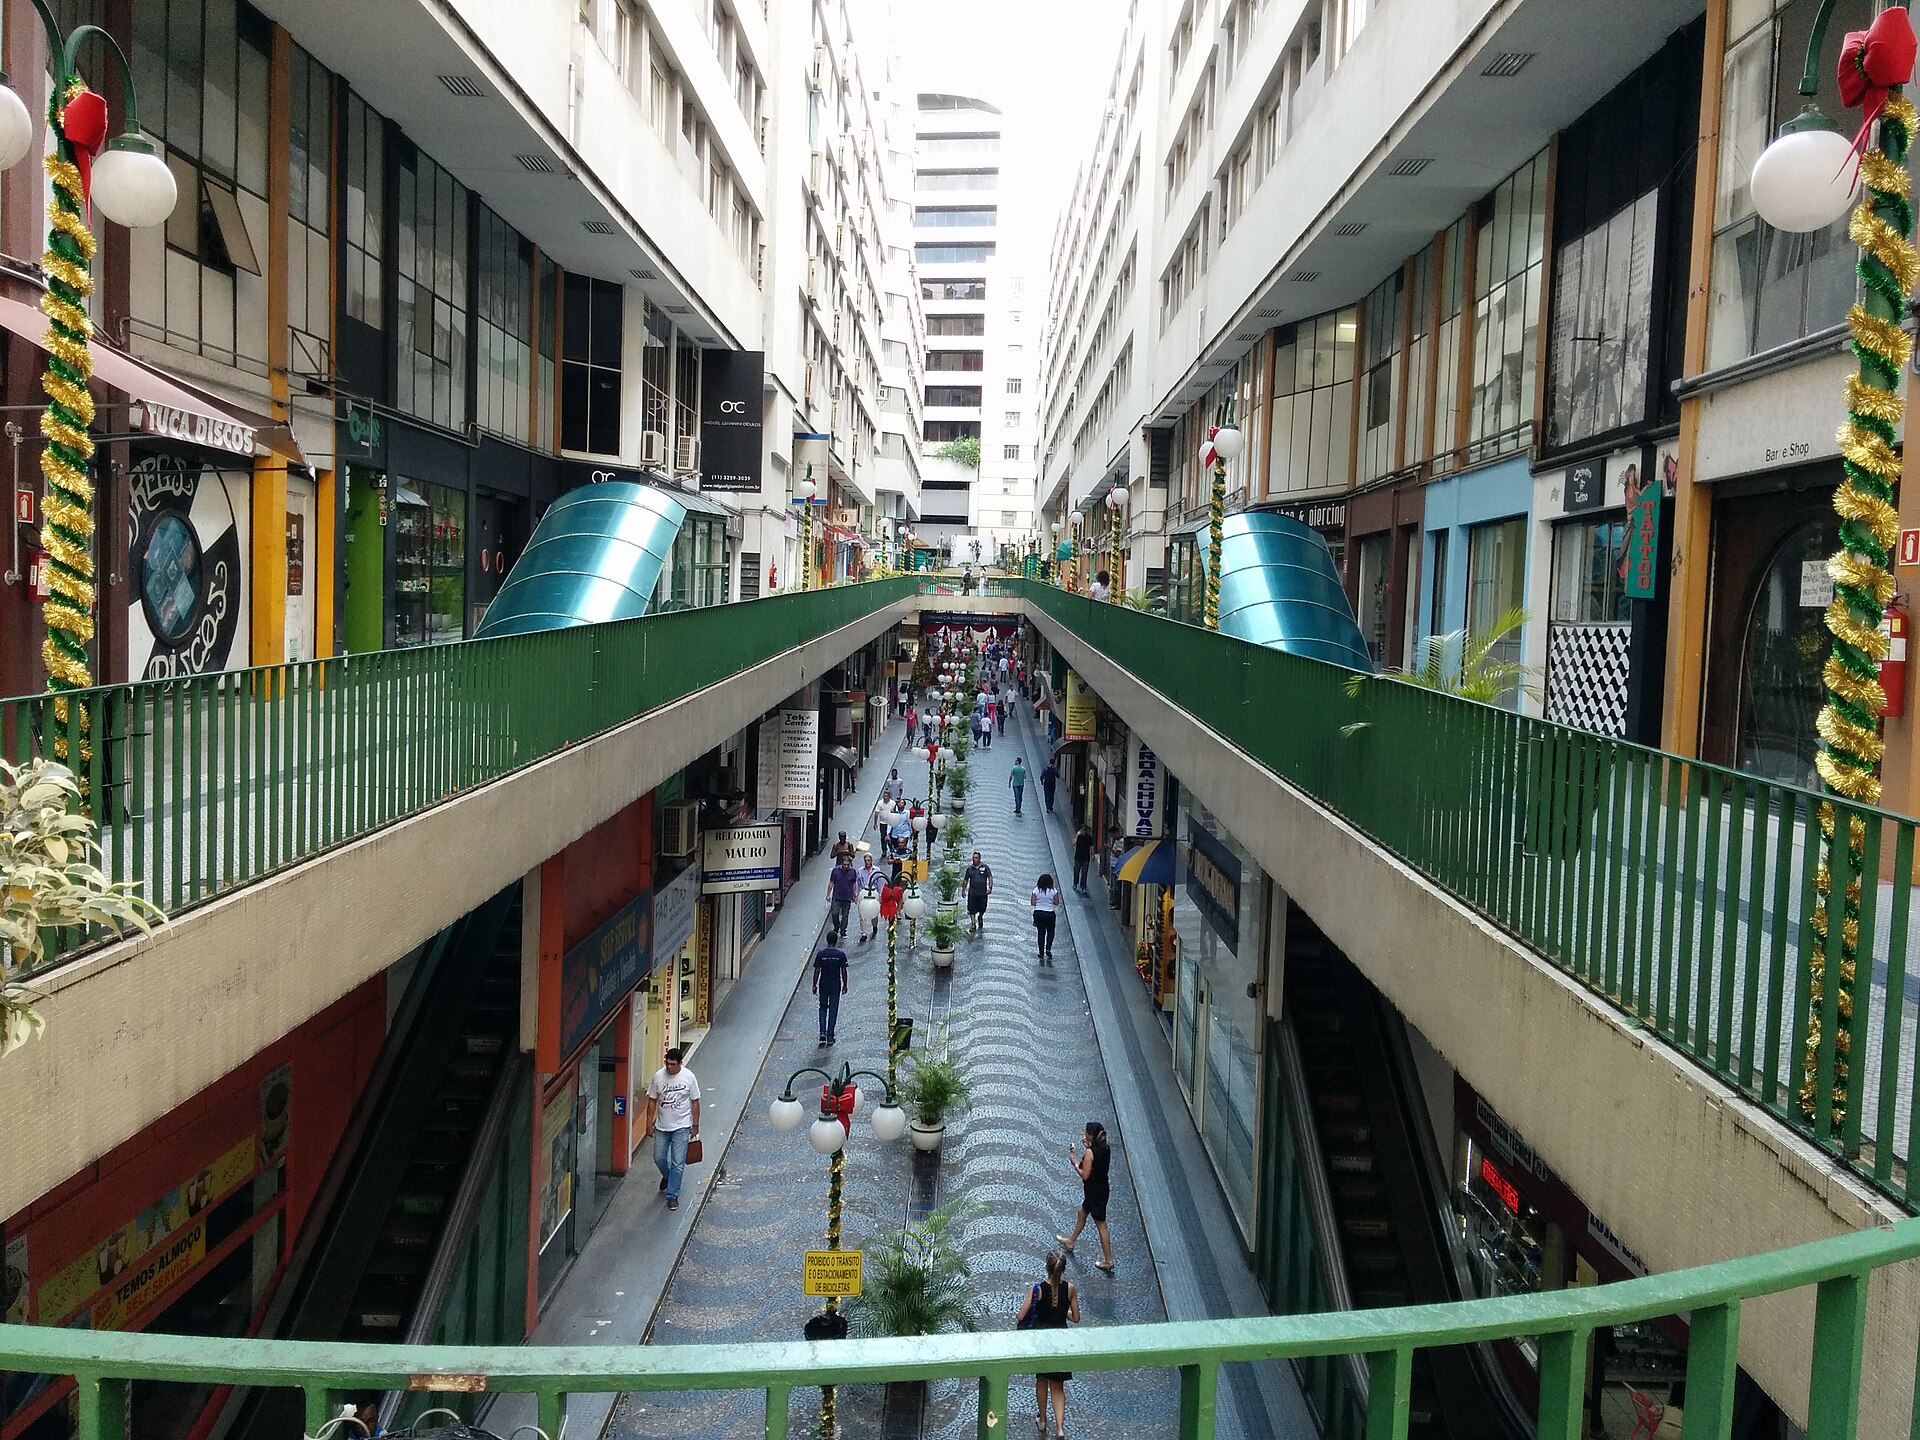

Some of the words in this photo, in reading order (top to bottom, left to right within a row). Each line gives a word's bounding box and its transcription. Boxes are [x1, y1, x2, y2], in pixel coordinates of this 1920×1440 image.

[146, 402, 191, 439] TUCA
[195, 415, 254, 454] DISCOS
[1765, 448, 1778, 462] Bar
[1782, 447, 1788, 459] e
[1789, 442, 1810, 457] Shop
[1637, 501, 1656, 590] TATTOO
[785, 713, 805, 721] Tek
[715, 829, 771, 842] RELOJOARIA
[724, 846, 767, 860] MAURO
[665, 965, 673, 1013] CONSERTO
[665, 1018, 671, 1030] DE
[116, 1263, 155, 1304] TEMOS
[158, 1226, 201, 1274] ALMOÇO
[807, 1256, 830, 1267] PROIBIDO
[830, 1256, 836, 1267] O
[836, 1254, 860, 1267] TRÂNSITO
[808, 1269, 812, 1280] E
[812, 1269, 817, 1280] O
[817, 1268, 858, 1280] ESTACIONAMENTO
[126, 1286, 150, 1316] SELF
[153, 1252, 192, 1294] SERVICE
[815, 1282, 822, 1292] DE
[822, 1282, 850, 1292] BICICLETAS
